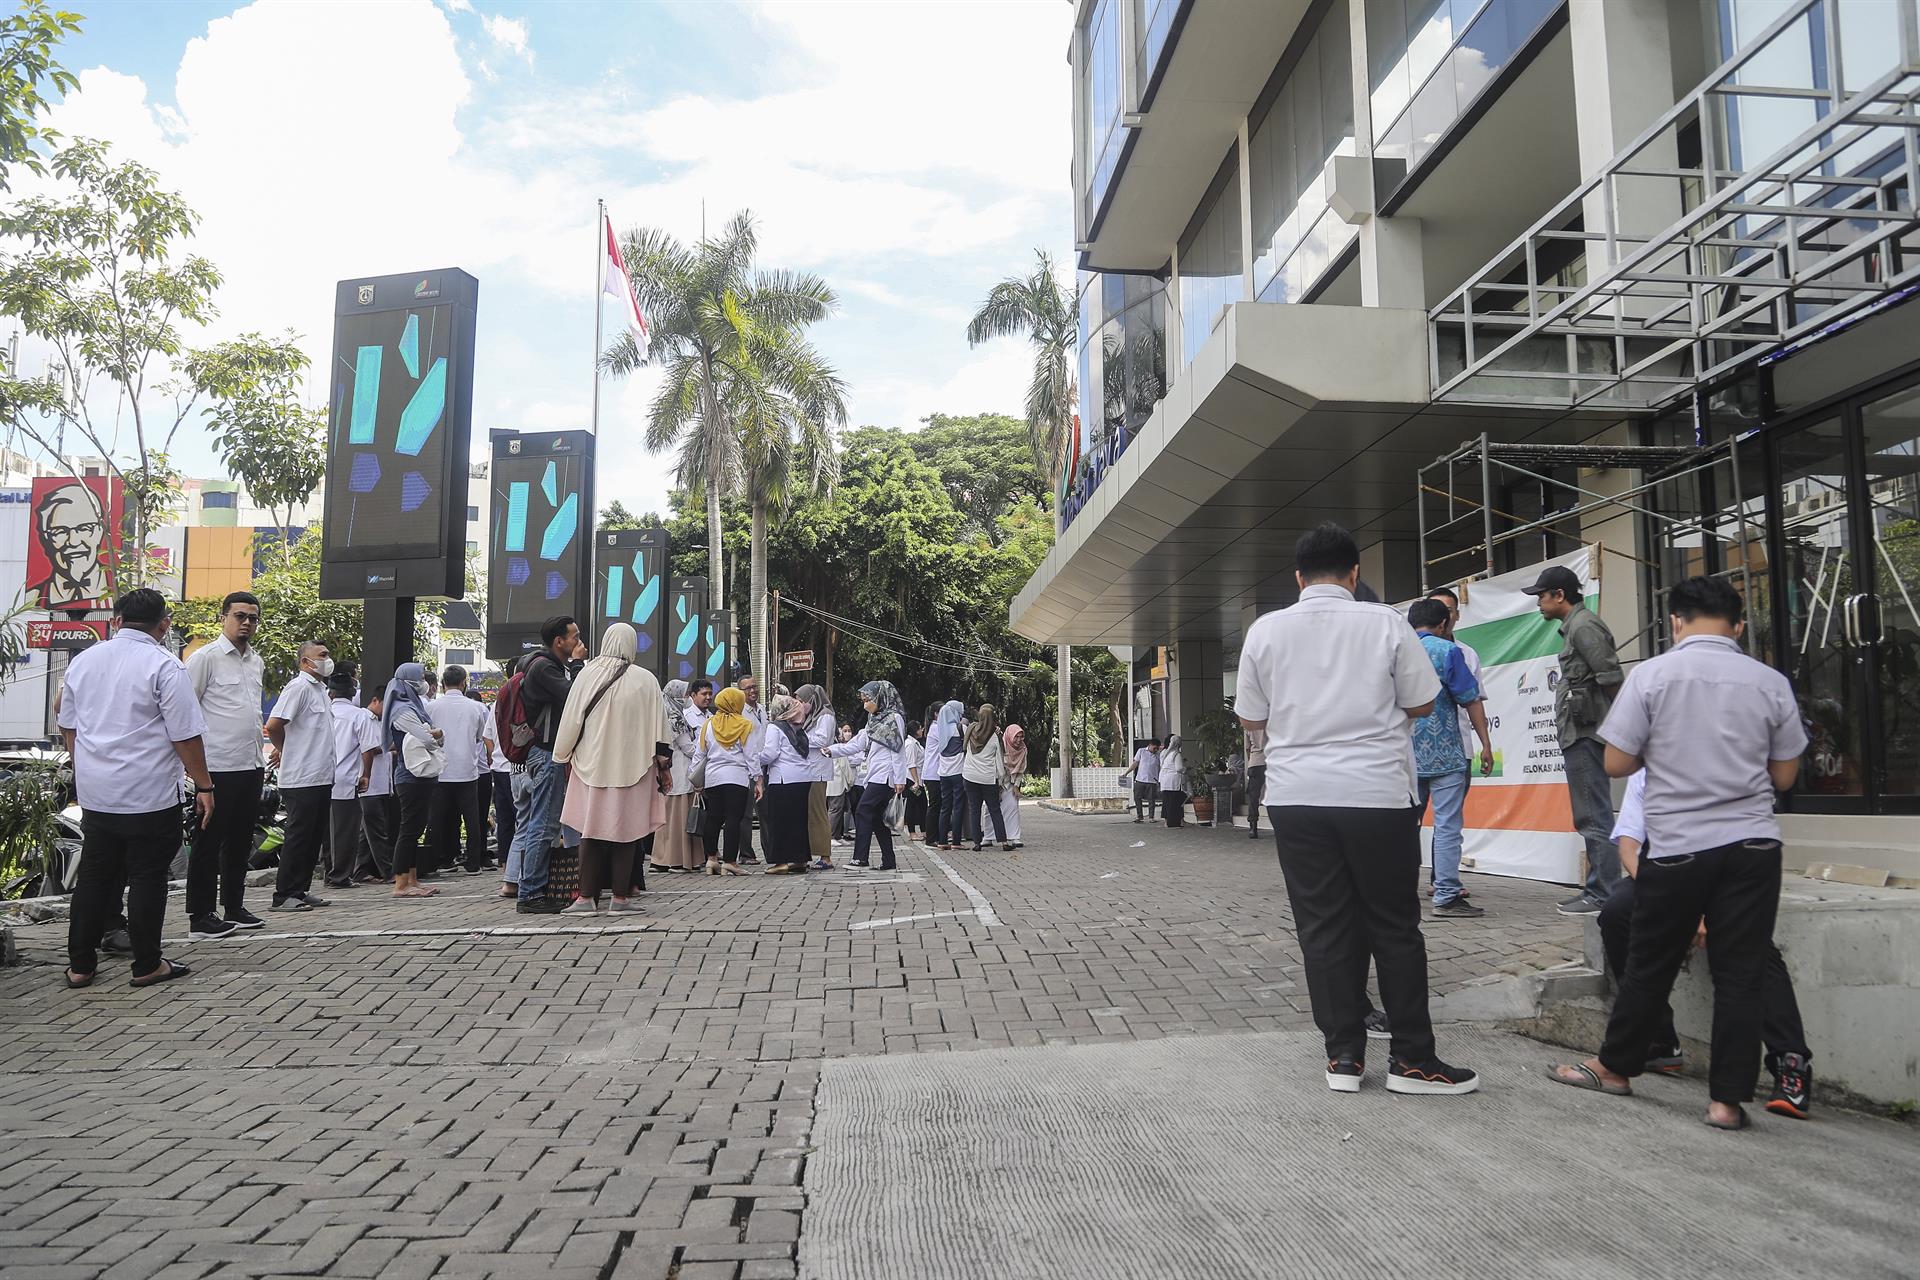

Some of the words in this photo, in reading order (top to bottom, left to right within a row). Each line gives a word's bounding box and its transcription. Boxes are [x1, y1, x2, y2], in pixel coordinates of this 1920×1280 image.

[31, 629, 51, 642] 24
[52, 630, 89, 640] HOURS
[1534, 733, 1558, 744] TERGAN
[1553, 763, 1566, 773] JAK
